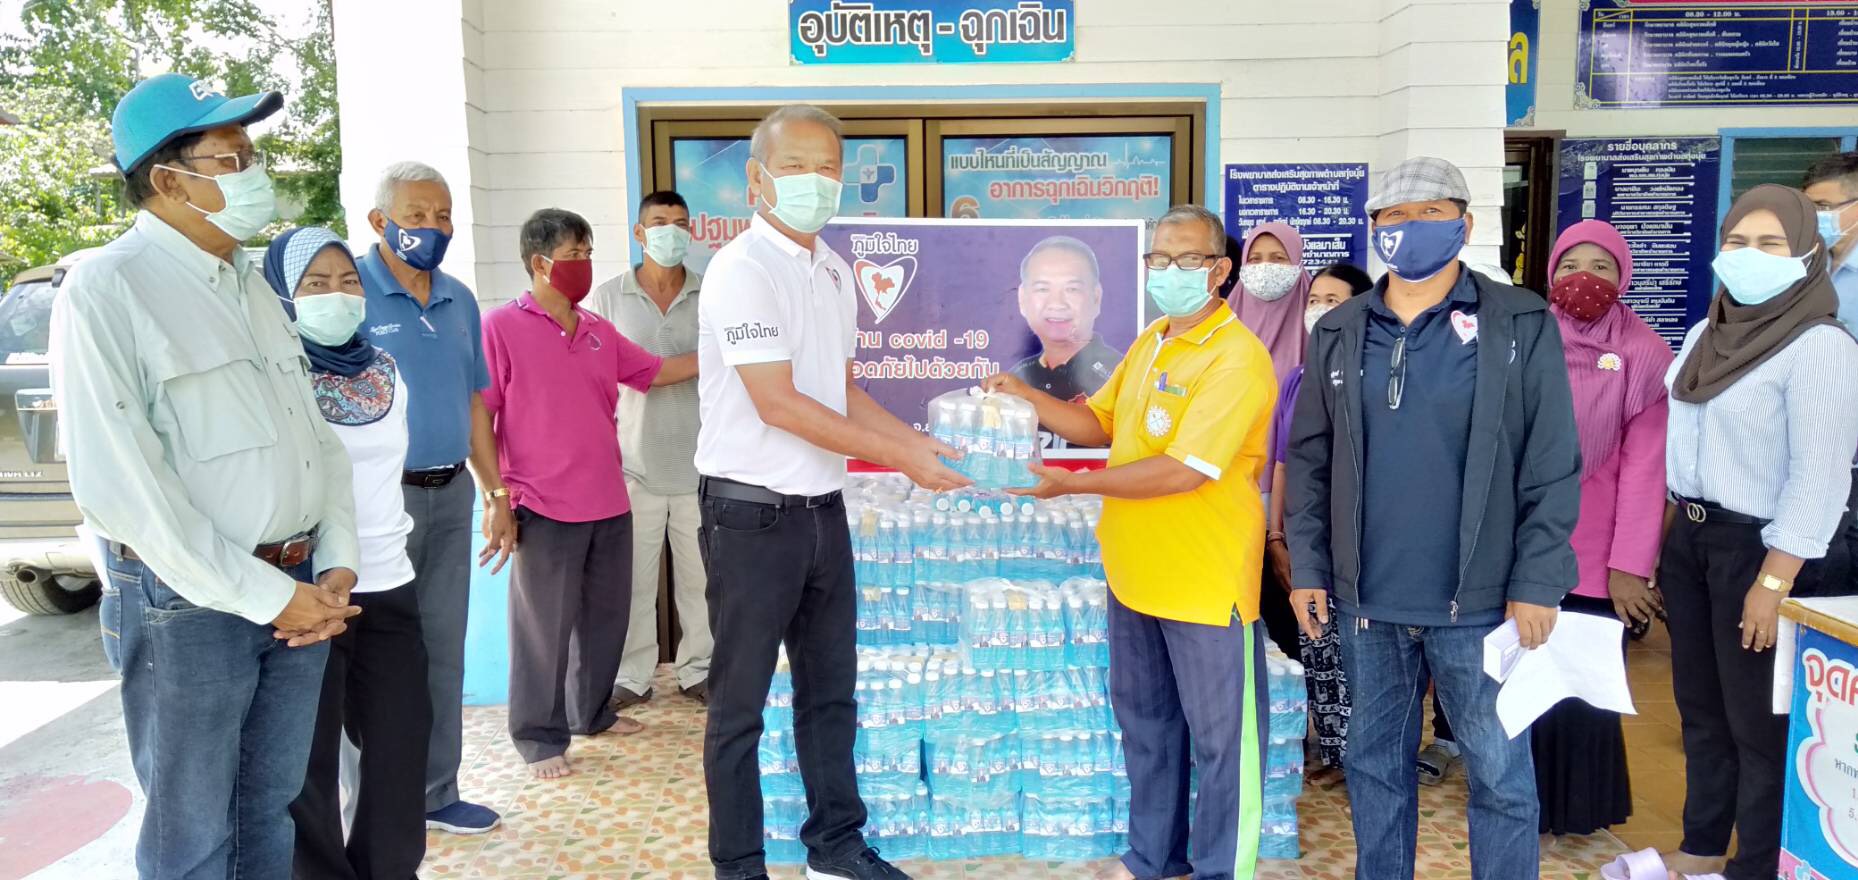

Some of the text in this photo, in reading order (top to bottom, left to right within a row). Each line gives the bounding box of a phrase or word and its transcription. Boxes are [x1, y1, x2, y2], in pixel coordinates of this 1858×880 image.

[799, 2, 931, 55] อุบัติเหตุ
[960, 2, 1066, 54] ฉุกเฉิน
[1607, 139, 1677, 153] รายชื่อบุคลากร
[950, 146, 1107, 172] แบบไหนที่เป็นสัญญาณ
[990, 175, 1160, 204] อาการฉุกเฉินวิกฤติ!
[852, 232, 919, 258] ภูมิใจไทย
[726, 322, 779, 345] ภูมิใจไทย
[889, 329, 947, 349] covid
[852, 355, 999, 379] อดภัยไปด้วยกัน
